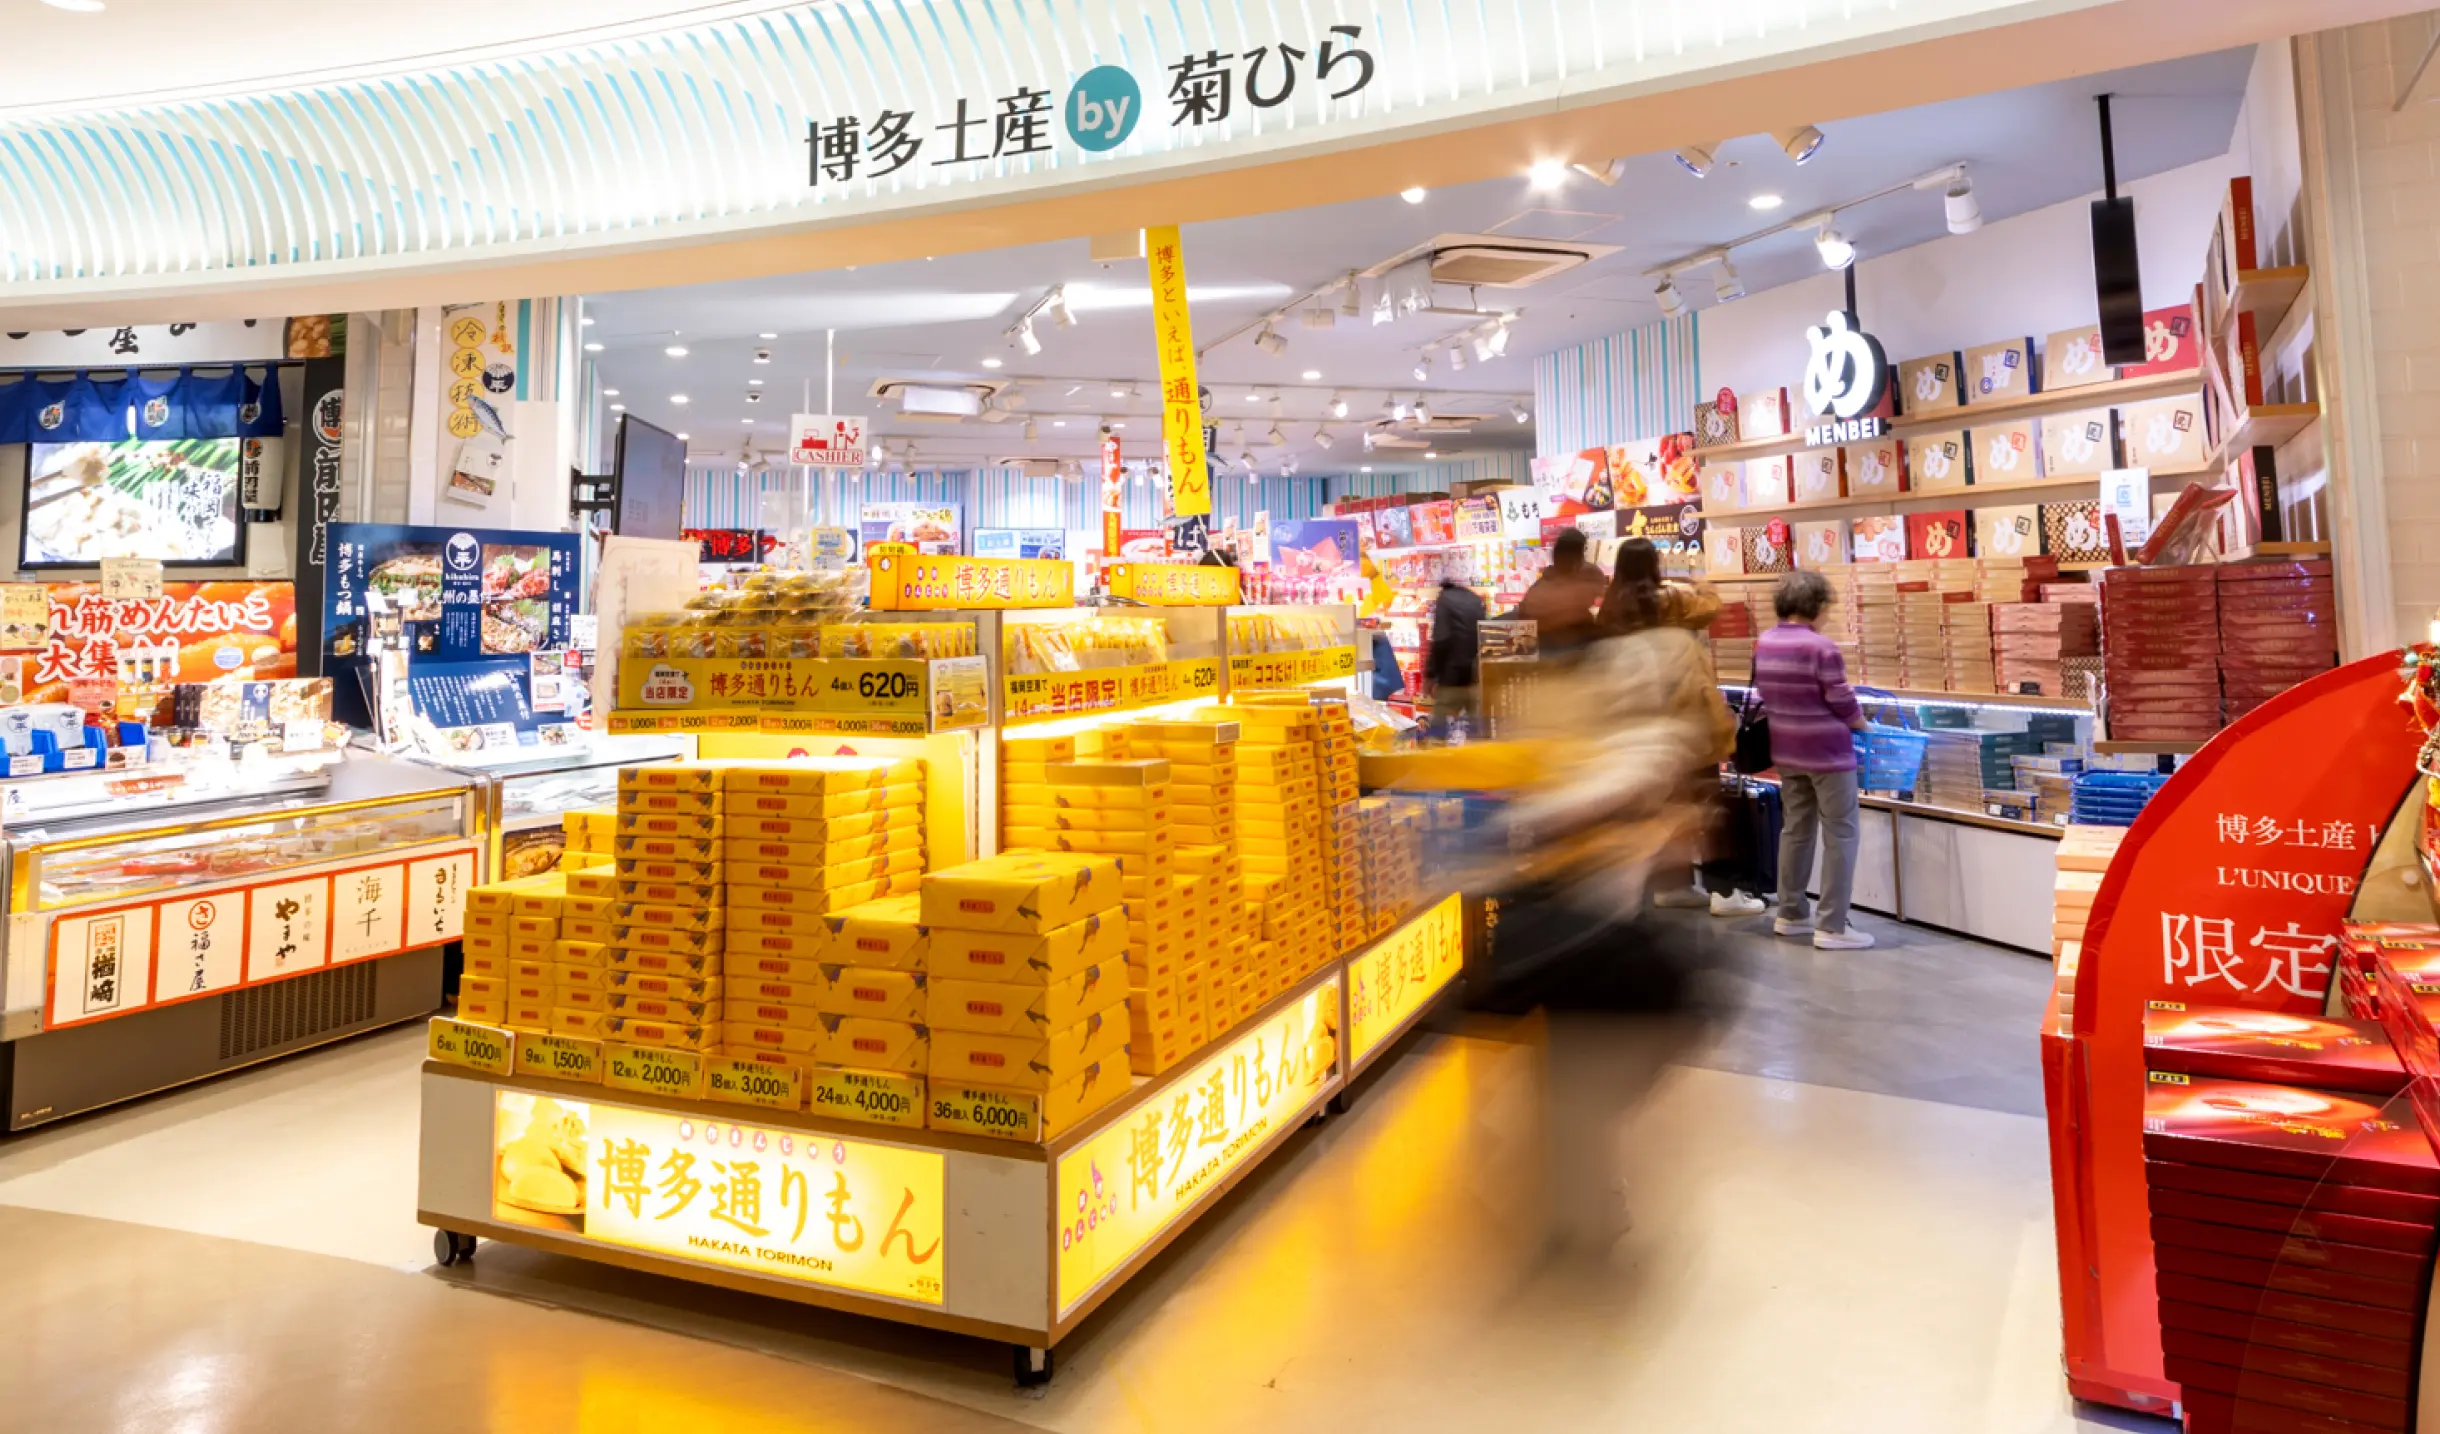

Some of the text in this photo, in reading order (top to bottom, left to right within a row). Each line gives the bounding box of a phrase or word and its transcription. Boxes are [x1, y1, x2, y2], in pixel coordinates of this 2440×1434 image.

[804, 25, 1375, 186] 博多土産 by 菊ひら
[2062, 336, 2095, 375] め
[2146, 320, 2179, 361] め
[1803, 310, 1875, 419] め
[1916, 367, 1942, 401] め
[1806, 417, 1880, 447] MENBEI
[795, 450, 862, 463] CASHIER
[1861, 451, 1884, 484] め
[1923, 444, 1950, 479] め
[1990, 434, 2019, 471] め
[1925, 521, 1952, 557] め
[1993, 517, 2023, 554] め
[2065, 512, 2097, 550] め
[955, 563, 1058, 603] 博多通りもん
[645, 686, 688, 700] 当店限定
[709, 671, 819, 699] 博多通りもん
[859, 672, 919, 698] 620円
[1051, 678, 1123, 714] 当店限定!
[2217, 813, 2356, 851] 博多土産
[2217, 867, 2355, 896] L'UNIQUE
[356, 876, 382, 937] 海千
[275, 898, 300, 959] やまや
[2160, 910, 2337, 999] 限定
[437, 1037, 500, 1061] 6個入 1,000円
[525, 1049, 592, 1071] 9個入 1,500円
[612, 1060, 691, 1087] 12個入 2,000円
[710, 1073, 789, 1097] 18個入 3,000円
[816, 1085, 911, 1113] 24個入 4,000円
[933, 1101, 1028, 1129] 36個入 6,000円
[1126, 1023, 1299, 1212] 博多通りもん
[1175, 1157, 1220, 1201] HAKATA
[597, 1137, 941, 1266] 博多通りもん
[688, 1235, 833, 1272] HAKATA TORIMON
